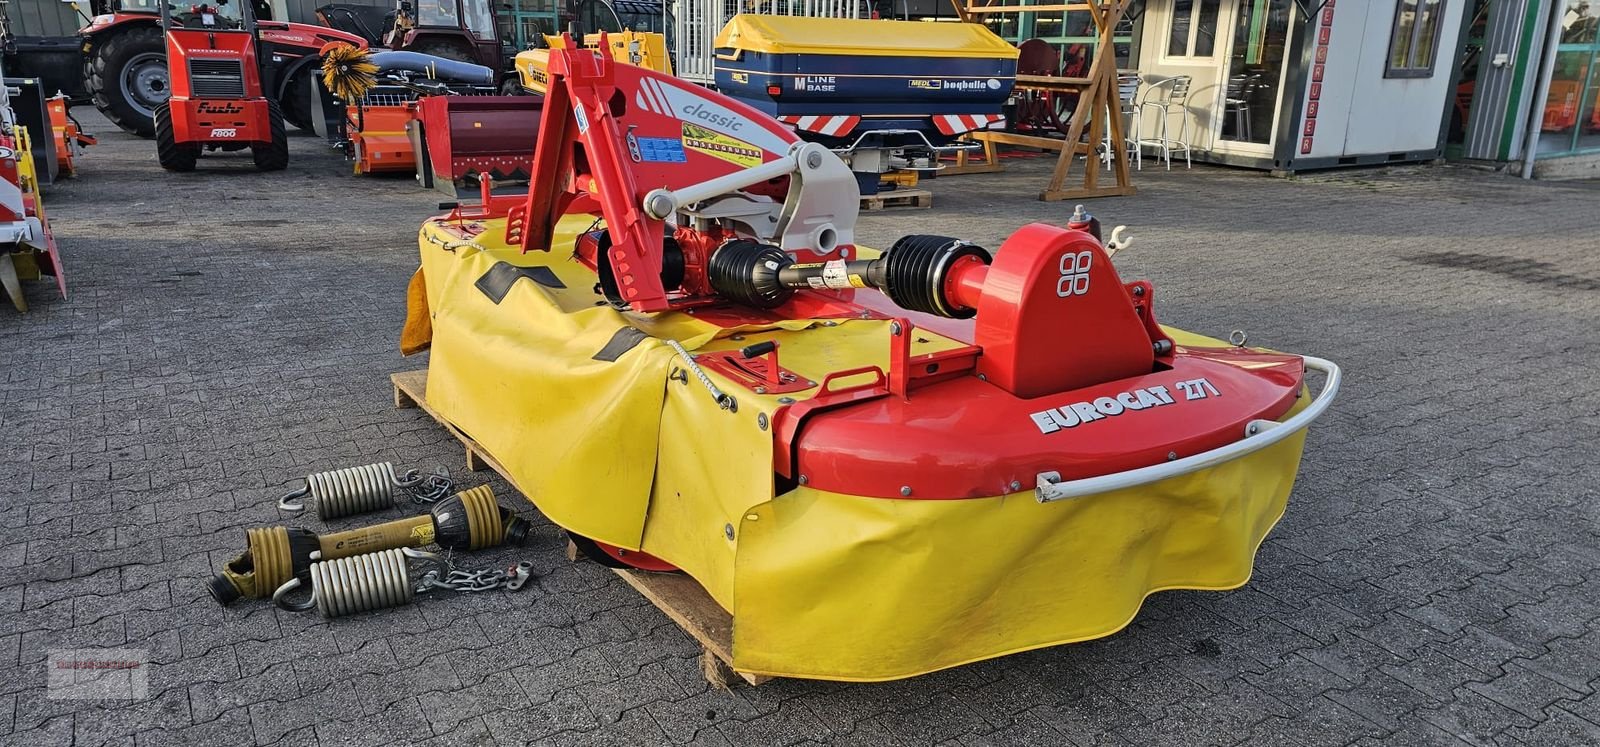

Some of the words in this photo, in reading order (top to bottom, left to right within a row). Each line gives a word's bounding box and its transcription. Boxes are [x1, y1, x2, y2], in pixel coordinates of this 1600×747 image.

[794, 77, 805, 90] M
[807, 76, 836, 84] LINE
[682, 103, 743, 131] classic
[1175, 377, 1222, 401] 271
[1029, 385, 1176, 434] EUROCAT
